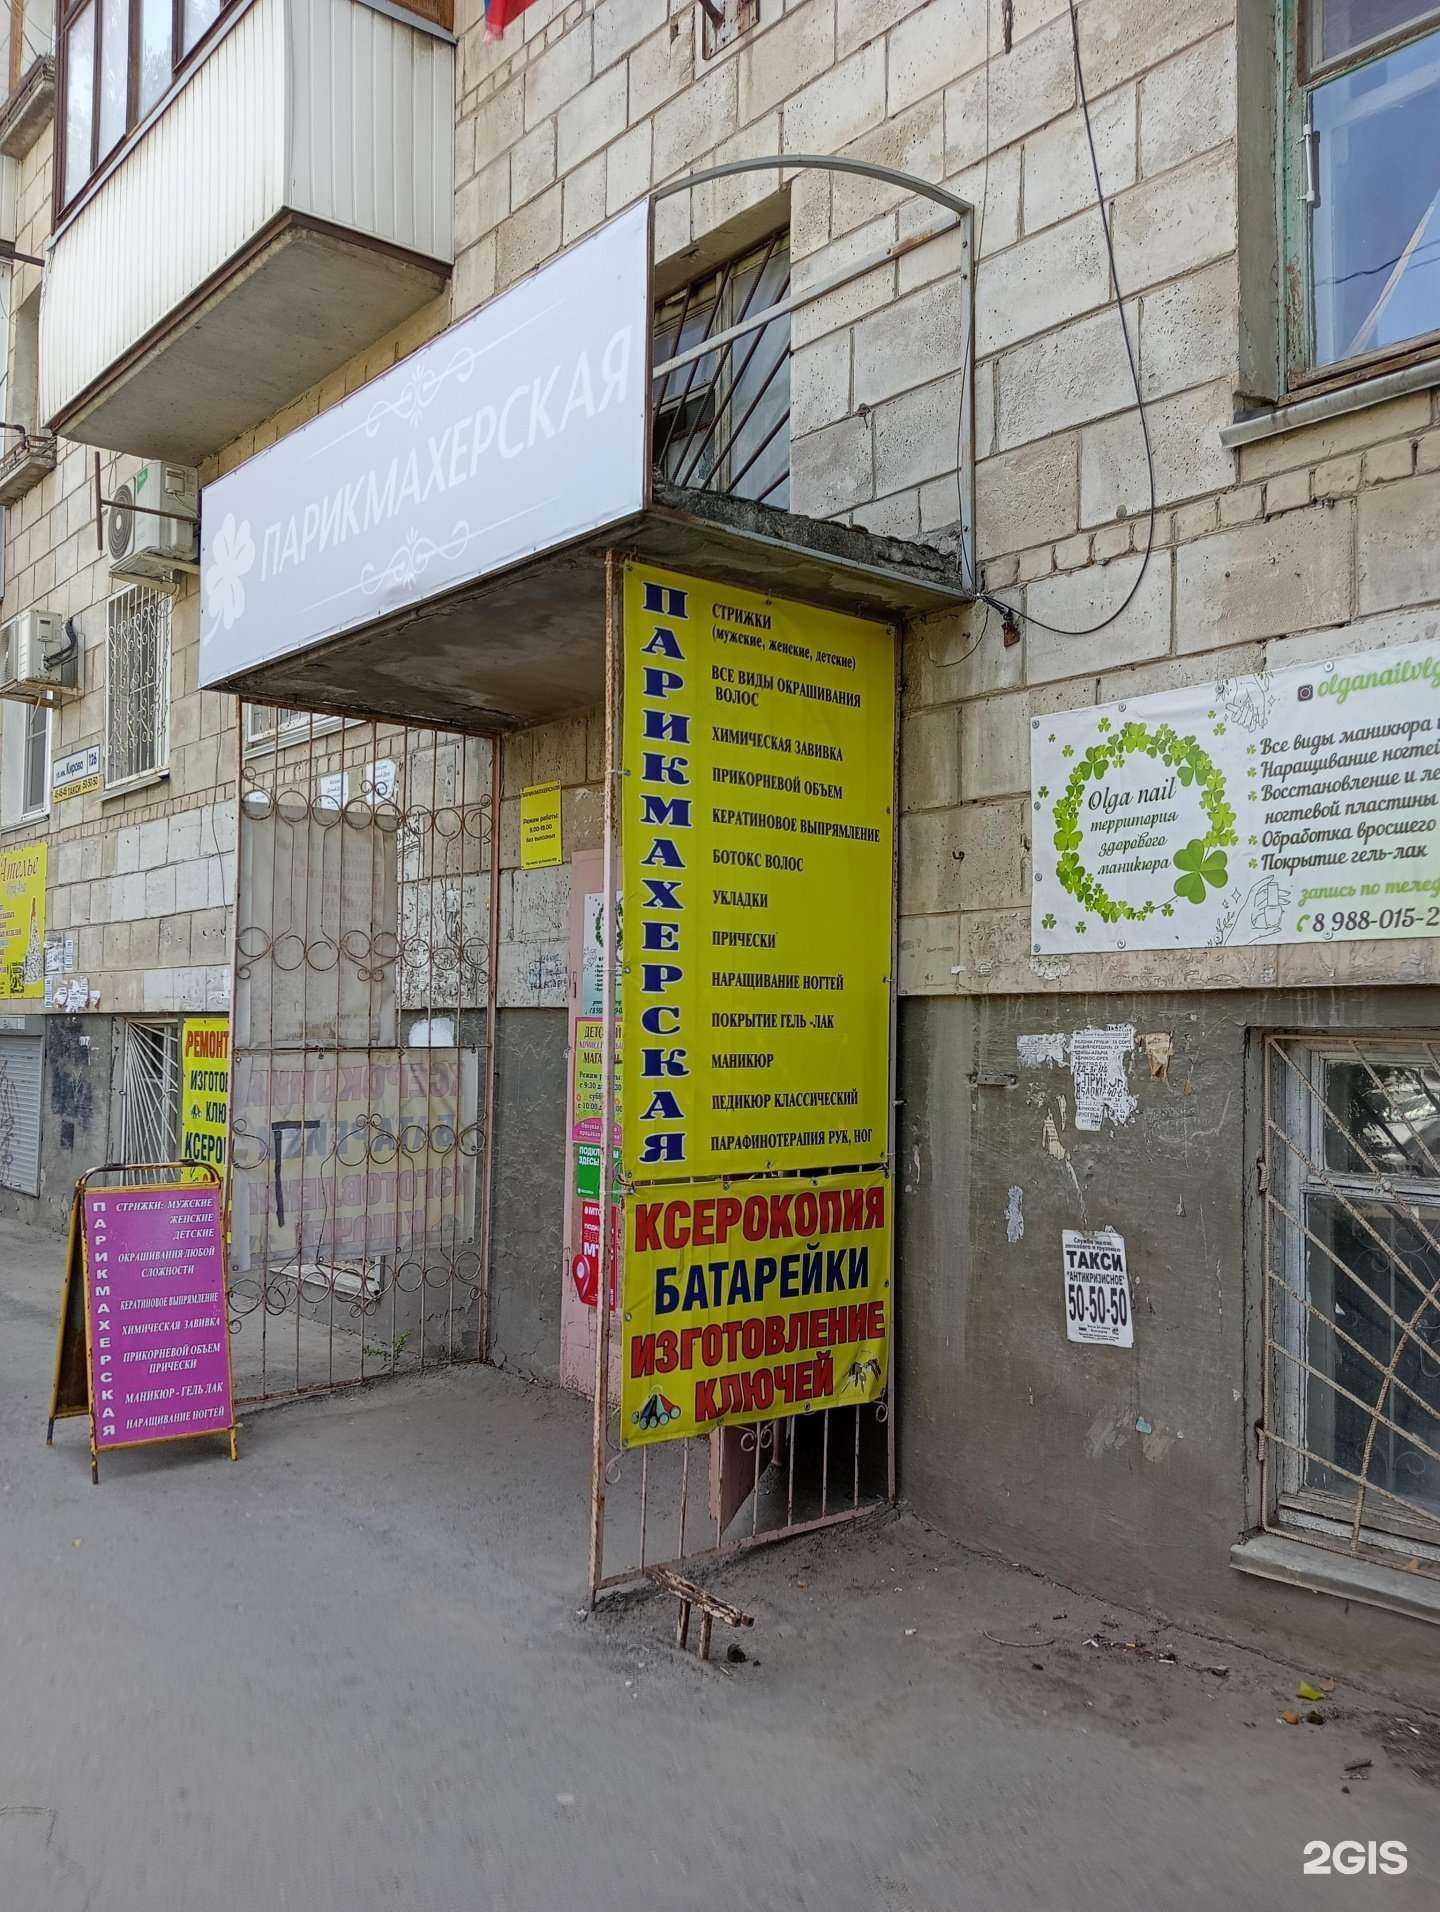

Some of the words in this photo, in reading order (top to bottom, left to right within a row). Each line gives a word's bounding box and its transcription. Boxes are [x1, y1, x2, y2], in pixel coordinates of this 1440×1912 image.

[258, 324, 632, 582] ПАРИКМАХЕРСКАЯ
[712, 603, 771, 630] СТРИЖКИ
[712, 625, 766, 650] (мужские,
[769, 638, 814, 663] женские,
[815, 648, 857, 671] детские)
[712, 664, 735, 682] ВСЕ
[738, 671, 774, 691] ВИДЫ
[777, 678, 861, 708] ОКРАШИВАНИЯ
[715, 687, 759, 707] ВОЛОС
[712, 726, 791, 753] ХИМИЧЕСКАЯ
[795, 740, 843, 762] ЗАВИВКА
[1260, 738, 1290, 755] Все
[1294, 731, 1335, 754] виды
[1340, 717, 1432, 745] маникюра
[1261, 752, 1379, 783] Наращивание
[712, 767, 801, 794] ПРИКОРНЕВОЙ
[804, 780, 842, 800] ОБЪЕМ
[1088, 786, 1134, 814] Olga
[1138, 777, 1177, 803] nail
[1261, 774, 1400, 802] Восстановление
[1405, 768, 1416, 784] и
[1265, 801, 1341, 824] ногтевой
[1345, 793, 1438, 816] пластины
[712, 808, 797, 832] КЕРАТИНОВОЕ
[800, 818, 880, 843] ВЫПРЯМЛЕНИЕ
[1090, 811, 1178, 833] территория
[1098, 832, 1167, 857] здорового
[1262, 828, 1353, 853] Обработка
[1357, 818, 1436, 845] вросшего
[640, 581, 692, 1164] ПАРИКМАХЕРСКАЯ
[712, 849, 761, 868] БОТОКС
[765, 854, 803, 872] ВОЛОС
[1097, 857, 1171, 875] маникюра
[1262, 852, 1349, 877] Покрытие
[1351, 844, 1428, 864] гель-лак
[712, 889, 768, 909] УКЛАДКИ
[1297, 886, 1356, 907] запись
[1361, 881, 1380, 896] по
[1312, 912, 1325, 932] 8
[712, 930, 776, 949] ПРИЧЕСКИ
[712, 971, 799, 991] НАРАЩИВАНИЕ
[803, 974, 844, 991] НОГТЕЙ
[712, 1012, 777, 1029] ПОКРЫТИЕ
[781, 1013, 806, 1029] ГЕЛЬ
[712, 1053, 774, 1069] МАНИКЮР
[712, 1094, 771, 1112] ПЕДИКЮР
[774, 1087, 858, 1108] КЛАССИЧЕСКИЙ
[711, 1133, 825, 1151] ПАРАФИНОТЕРАПИЯ
[828, 1131, 851, 1148] РУК,
[854, 1129, 873, 1144] НОГ
[116, 1201, 164, 1212] СТРИЖКИ:
[167, 1198, 213, 1209] МУЖСКИЕ
[169, 1213, 214, 1224] ЖЕНСКИЕ
[634, 1186, 886, 1253] КСЕРОКОПИЯ
[173, 1228, 215, 1240] ДЕТСКИЕ
[118, 1250, 184, 1262] ОКРАШИВАНИЯ
[184, 1246, 215, 1259] ЛЮБОЙ
[1066, 1251, 1123, 1273] ТАКСИ
[141, 1265, 194, 1278] СЛОЖНОСТИ
[655, 1241, 869, 1316] БАТАРЕЙКИ
[120, 1298, 168, 1311] КЕРАТИНОВОЕ
[169, 1292, 219, 1306] ВЫПРЯМЛЕНИЕ
[93, 1202, 115, 1436] ПАРИКМАХЕРСКАЯ
[122, 1321, 181, 1336] ХИМИЧЕСКАЯ
[184, 1317, 220, 1329] ЗАВИВКА
[630, 1300, 886, 1379] ИЗГОТОВЛЕНИЕ
[123, 1344, 189, 1363] ПРИКОРНЕВОЙ
[190, 1343, 221, 1355] ОБЪЕМ
[149, 1358, 197, 1374] ПРИЧЕСКИ
[125, 1389, 175, 1404] МАНИКЮР
[181, 1385, 203, 1397] ГЕЛЬ
[204, 1382, 224, 1394] ЛАК
[694, 1349, 834, 1423] КЛЮЧЕЙ
[126, 1412, 192, 1429] НАРАЩИВАНИЕ
[193, 1406, 225, 1420] НОГТЕЙ
